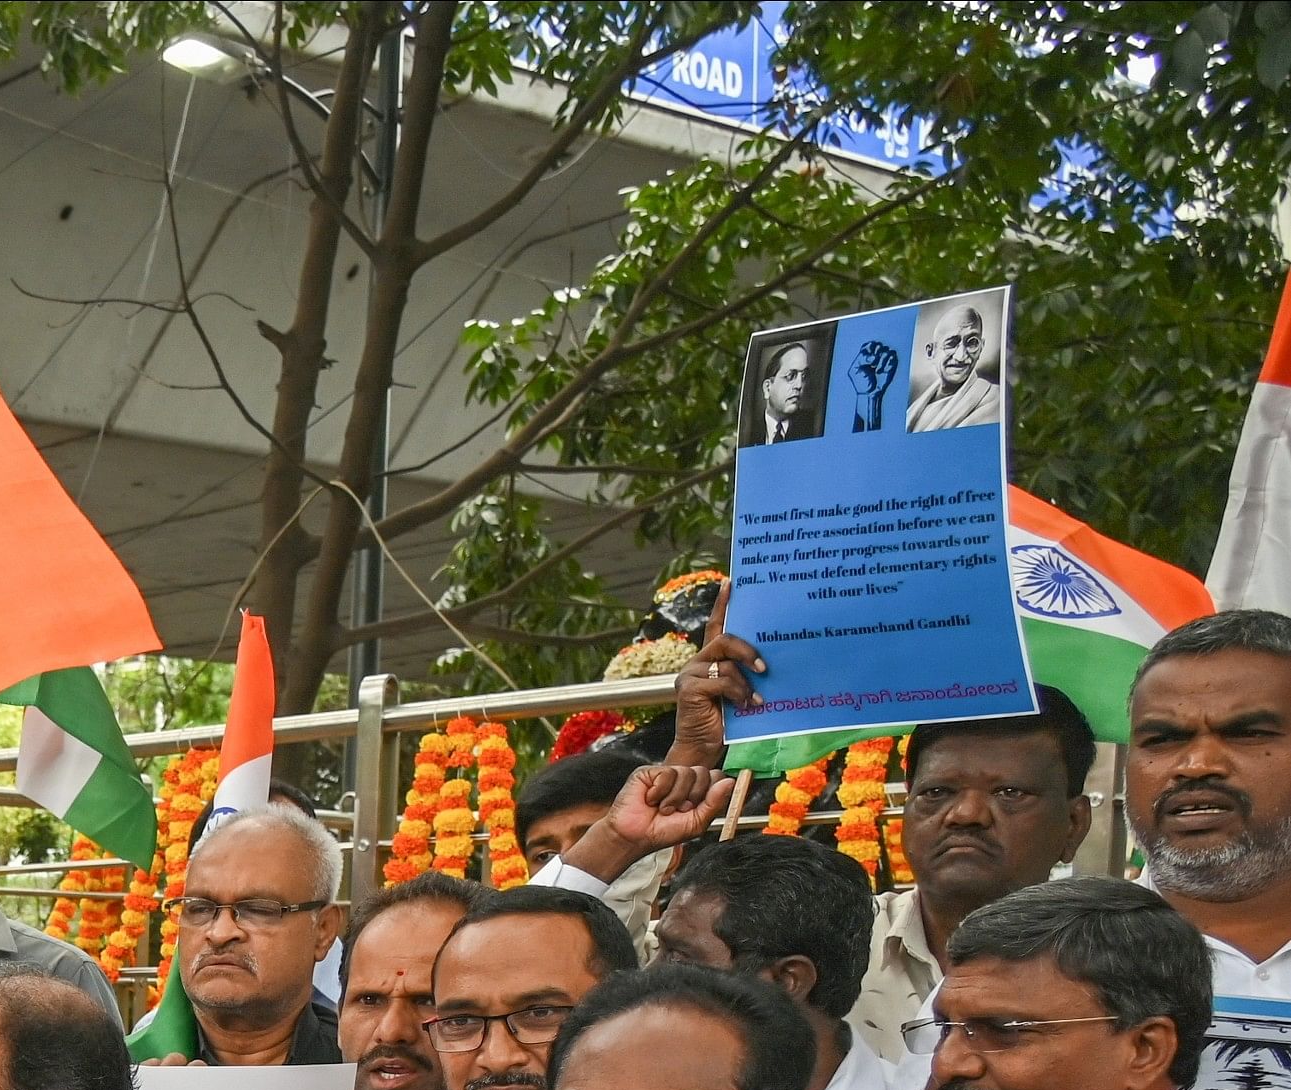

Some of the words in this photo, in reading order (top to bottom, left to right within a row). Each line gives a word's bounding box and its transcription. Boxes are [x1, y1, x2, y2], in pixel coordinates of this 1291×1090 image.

[673, 52, 742, 99] ROAD
[738, 513, 759, 525] "We
[761, 510, 787, 523] must
[790, 508, 813, 520] first
[816, 503, 850, 517] make
[852, 499, 882, 517] good
[885, 498, 907, 511] the
[910, 494, 944, 510] right
[947, 490, 964, 504] of
[965, 489, 995, 502] free
[737, 531, 771, 548] speech
[773, 528, 794, 542] and
[796, 527, 820, 540] free
[822, 521, 894, 537] association
[897, 516, 942, 530] before
[945, 516, 966, 525] we
[969, 513, 995, 523] can
[741, 551, 769, 565] make
[770, 553, 789, 564] any
[793, 546, 839, 560] further
[841, 544, 899, 560] progress
[901, 534, 960, 551] towards
[963, 534, 989, 545] our
[736, 572, 765, 588] goal...
[768, 571, 786, 582] We
[788, 569, 817, 581] must
[820, 563, 865, 578] defend
[868, 559, 947, 574] elementary
[952, 553, 996, 569] rights
[807, 586, 836, 599] with
[839, 587, 863, 597] our
[865, 580, 903, 595] lives"
[756, 628, 821, 642] Mohandas
[824, 618, 914, 637] Karamchand
[917, 614, 970, 628] Gandhi
